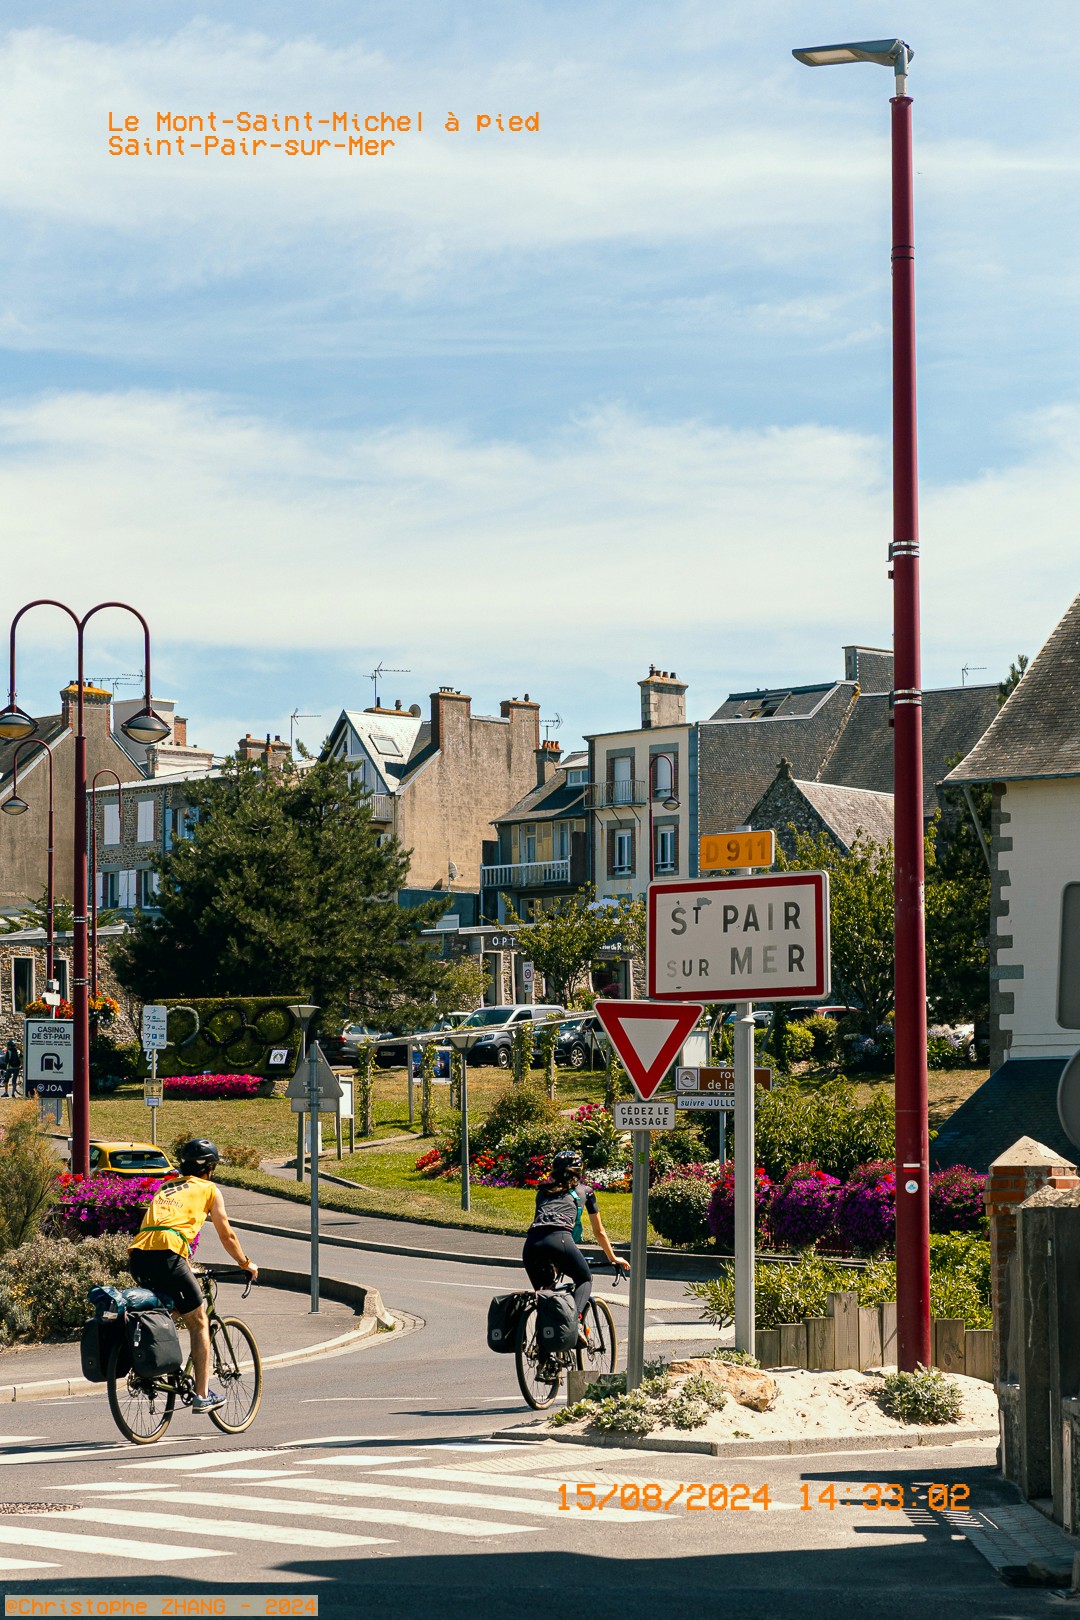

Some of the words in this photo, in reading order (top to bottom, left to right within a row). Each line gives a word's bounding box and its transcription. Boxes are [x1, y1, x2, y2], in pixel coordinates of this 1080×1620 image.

[705, 840, 720, 863] D
[727, 836, 767, 862] 911
[723, 901, 801, 933] PAIR
[492, 936, 516, 947] OPT
[667, 958, 710, 978] SUR
[730, 944, 805, 976] MER
[720, 1070, 735, 1080] rou
[708, 1079, 722, 1090] de
[724, 1080, 734, 1090] la
[708, 1099, 735, 1107] JULLO
[620, 1105, 654, 1116] CÉDEZ
[658, 1107, 670, 1116] LE
[622, 1117, 668, 1126] PASSAGE
